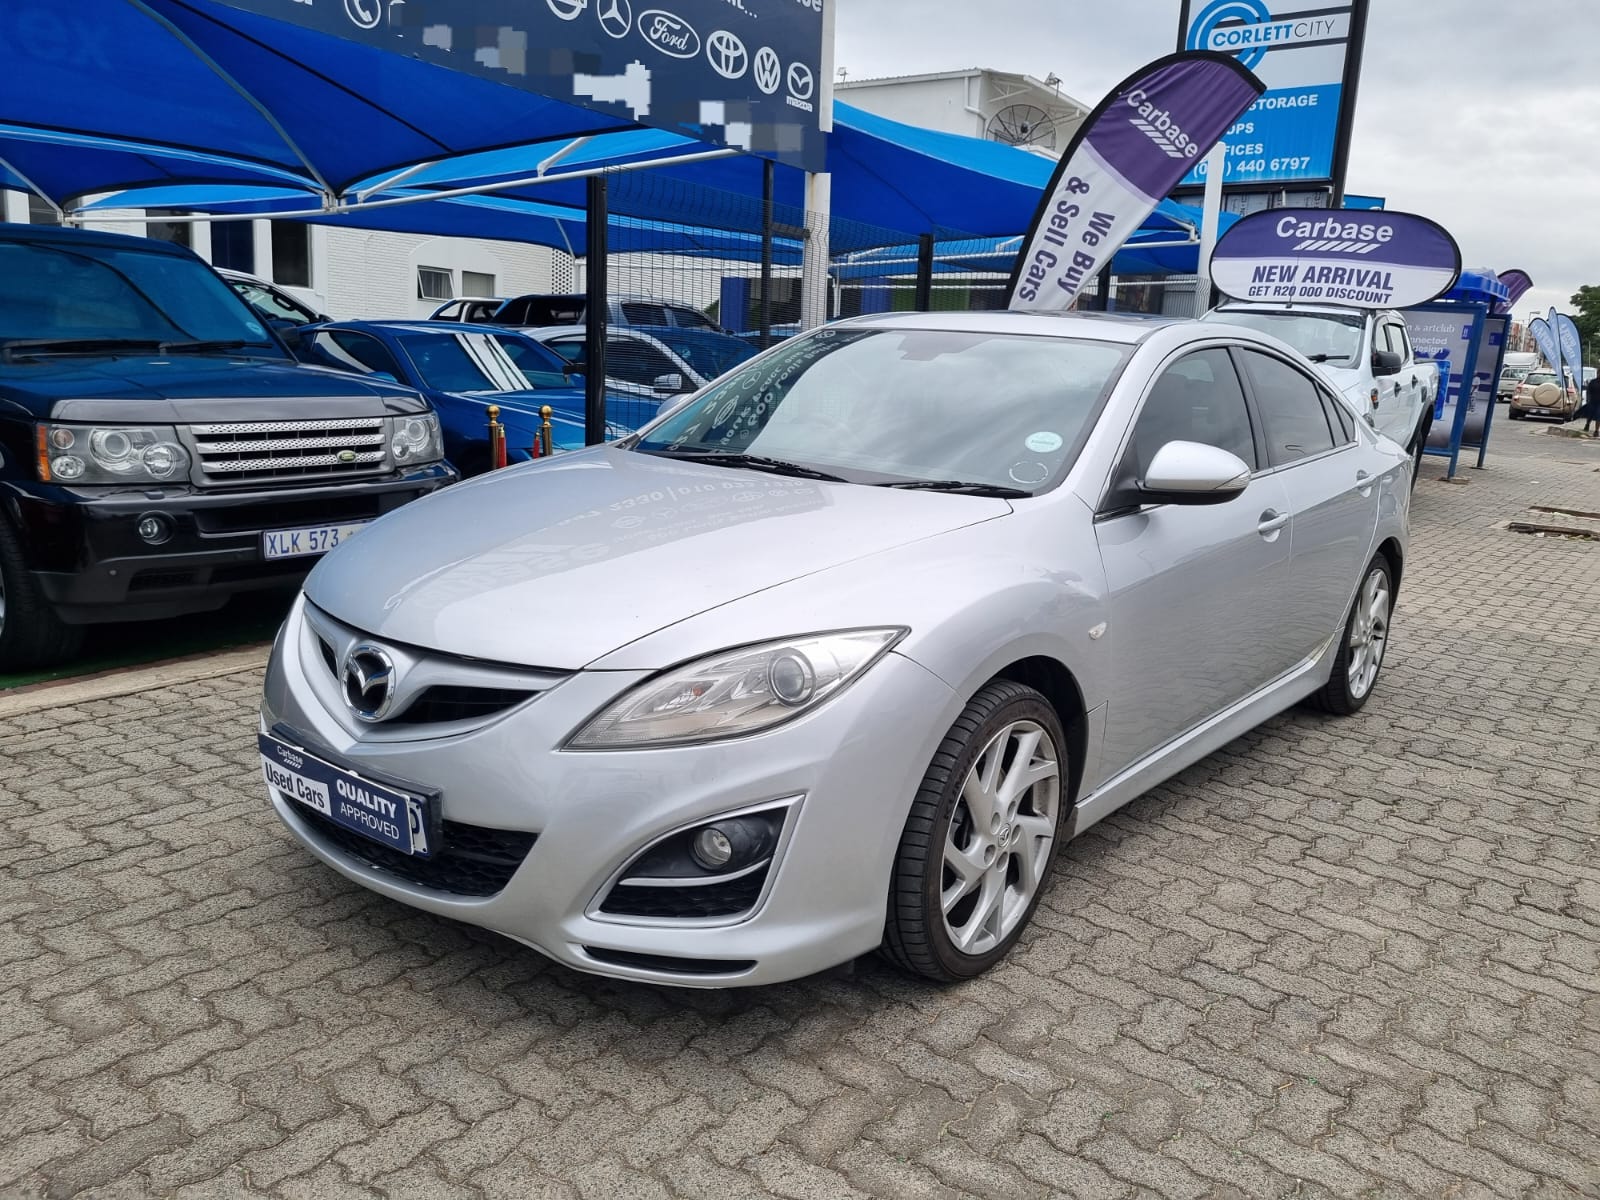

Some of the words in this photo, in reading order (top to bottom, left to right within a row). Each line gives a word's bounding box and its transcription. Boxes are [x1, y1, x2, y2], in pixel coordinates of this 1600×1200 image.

[650, 16, 690, 51] Ford
[1127, 89, 1198, 158] Carbase
[1236, 159, 1266, 173] 440
[1270, 156, 1311, 171] 6797
[1064, 176, 1090, 194] &
[1043, 200, 1080, 247] Sell
[1081, 211, 1116, 247] We
[1276, 216, 1394, 242] Carbase
[1018, 249, 1058, 302] Cars
[1057, 250, 1096, 296] Buy
[1252, 265, 1299, 283] NEW
[1302, 265, 1394, 291] ARRIVAL
[1248, 285, 1271, 297] GET
[1273, 285, 1297, 297] R20
[1299, 286, 1324, 298] 000
[1325, 287, 1393, 304] DISCOUNT
[267, 532, 302, 555] XLK
[309, 528, 339, 551] 573
[276, 745, 304, 765] Carbase
[264, 761, 295, 794] Used
[296, 777, 325, 809] Cars
[336, 778, 397, 819] QUALITY
[340, 801, 400, 840] APPROVED
